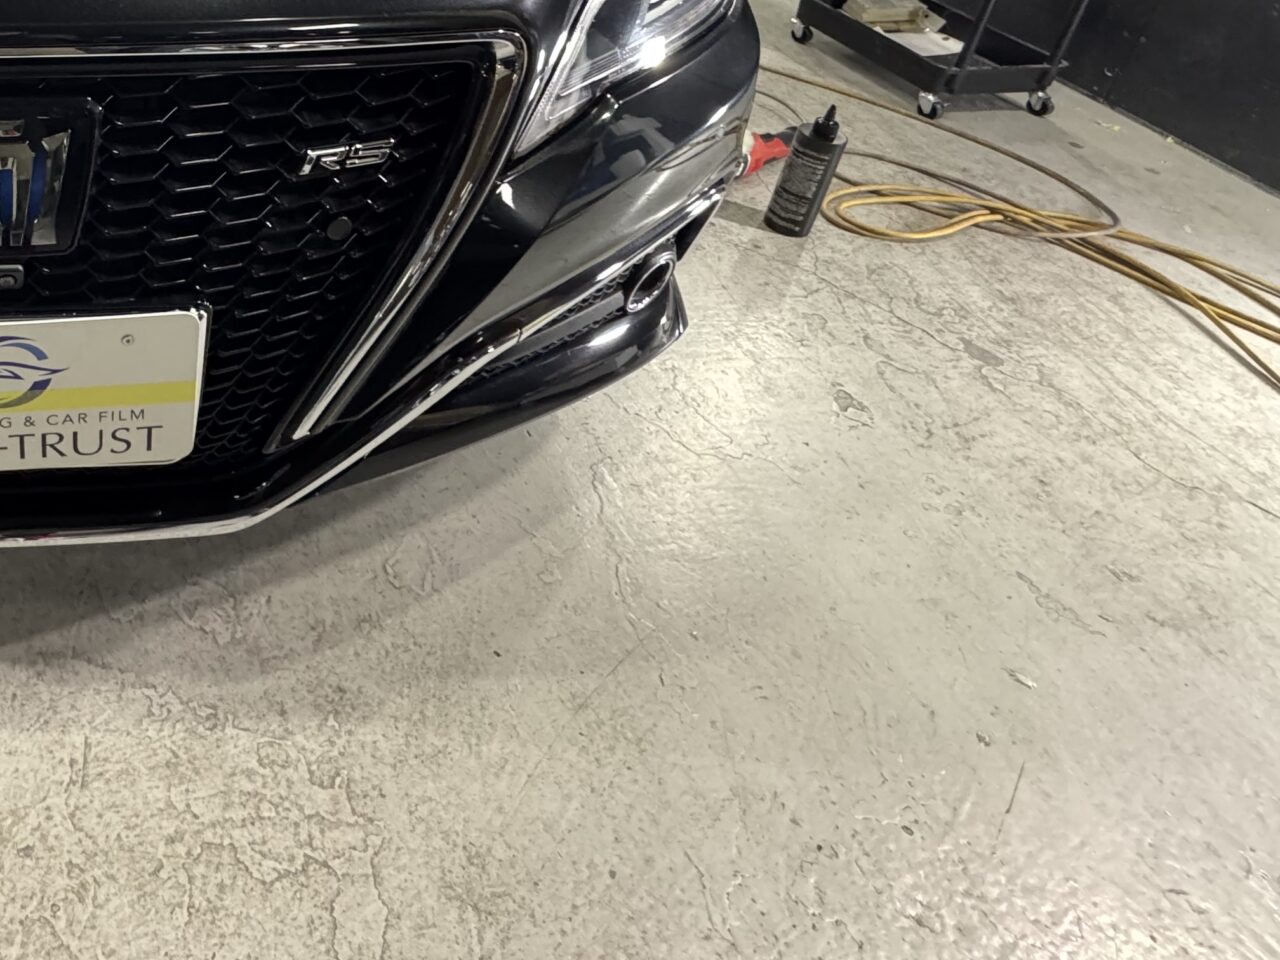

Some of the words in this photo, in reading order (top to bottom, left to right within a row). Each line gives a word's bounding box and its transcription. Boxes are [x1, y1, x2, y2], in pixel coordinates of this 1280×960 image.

[299, 138, 395, 176] RS
[23, 415, 36, 428] &
[46, 412, 89, 426] CAR
[98, 408, 146, 423] FILM
